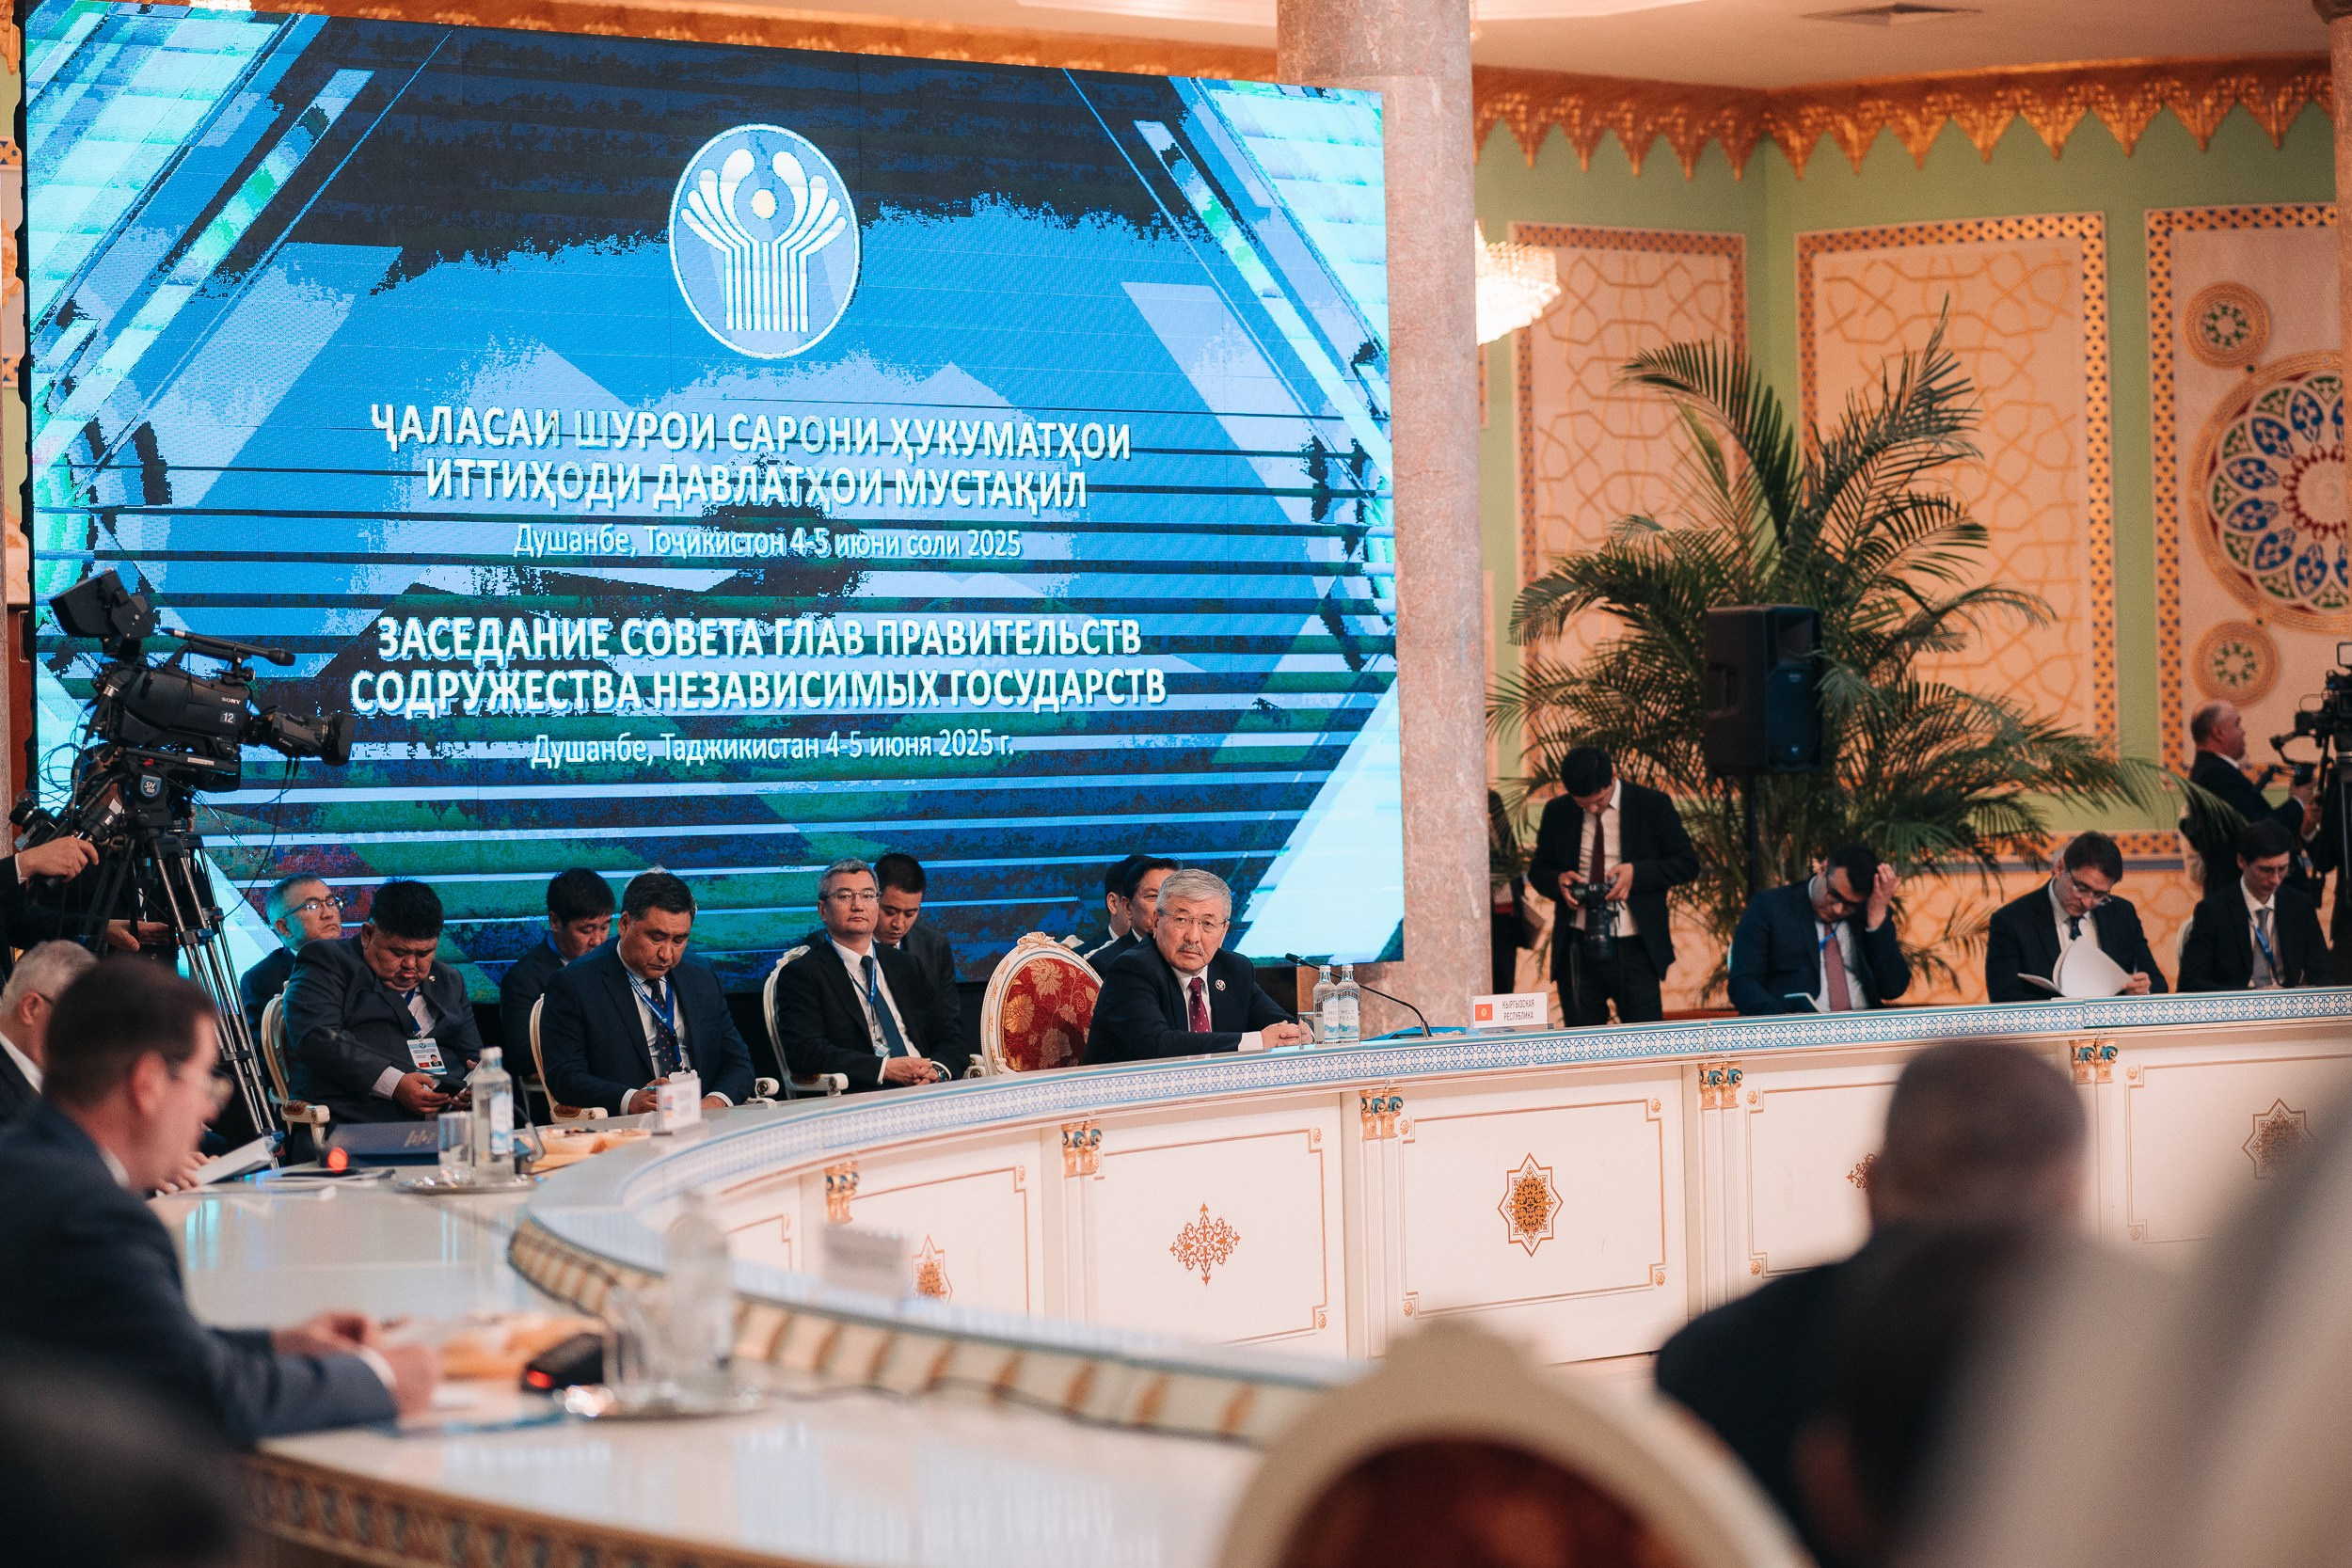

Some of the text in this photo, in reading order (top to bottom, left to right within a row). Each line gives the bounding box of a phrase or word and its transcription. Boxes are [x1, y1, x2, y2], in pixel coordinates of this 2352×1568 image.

[371, 404, 1131, 467] ҶАЛАСАИ ШУРОИ САРОНИ ҲУКУМАТҲОИ
[426, 457, 1088, 515] ИТТИҲОДИ ДАВЛАТҲОИ МУСТАҚИЛ
[513, 523, 1022, 559] Душанбе, Тоҷикистон 4-5 июни соли 2025
[377, 616, 1142, 668] ЗАСЕДАНИЕ СОВЕТА ГЛАВ ПРАВИТЕЛЬСТВ
[350, 668, 1168, 721] СОДРУЖЕСТВА НЕЗАВИСИМЫХ ГОСУДАРСТВ
[223, 712, 235, 723] 12
[531, 728, 1015, 769] Душанбе, Таджикистан 4-5 июня 2025 г.
[1502, 999, 1535, 1009] КЫРГЫЗСКАЯ
[1503, 1012, 1534, 1022] РЕСПУБЛИКА
